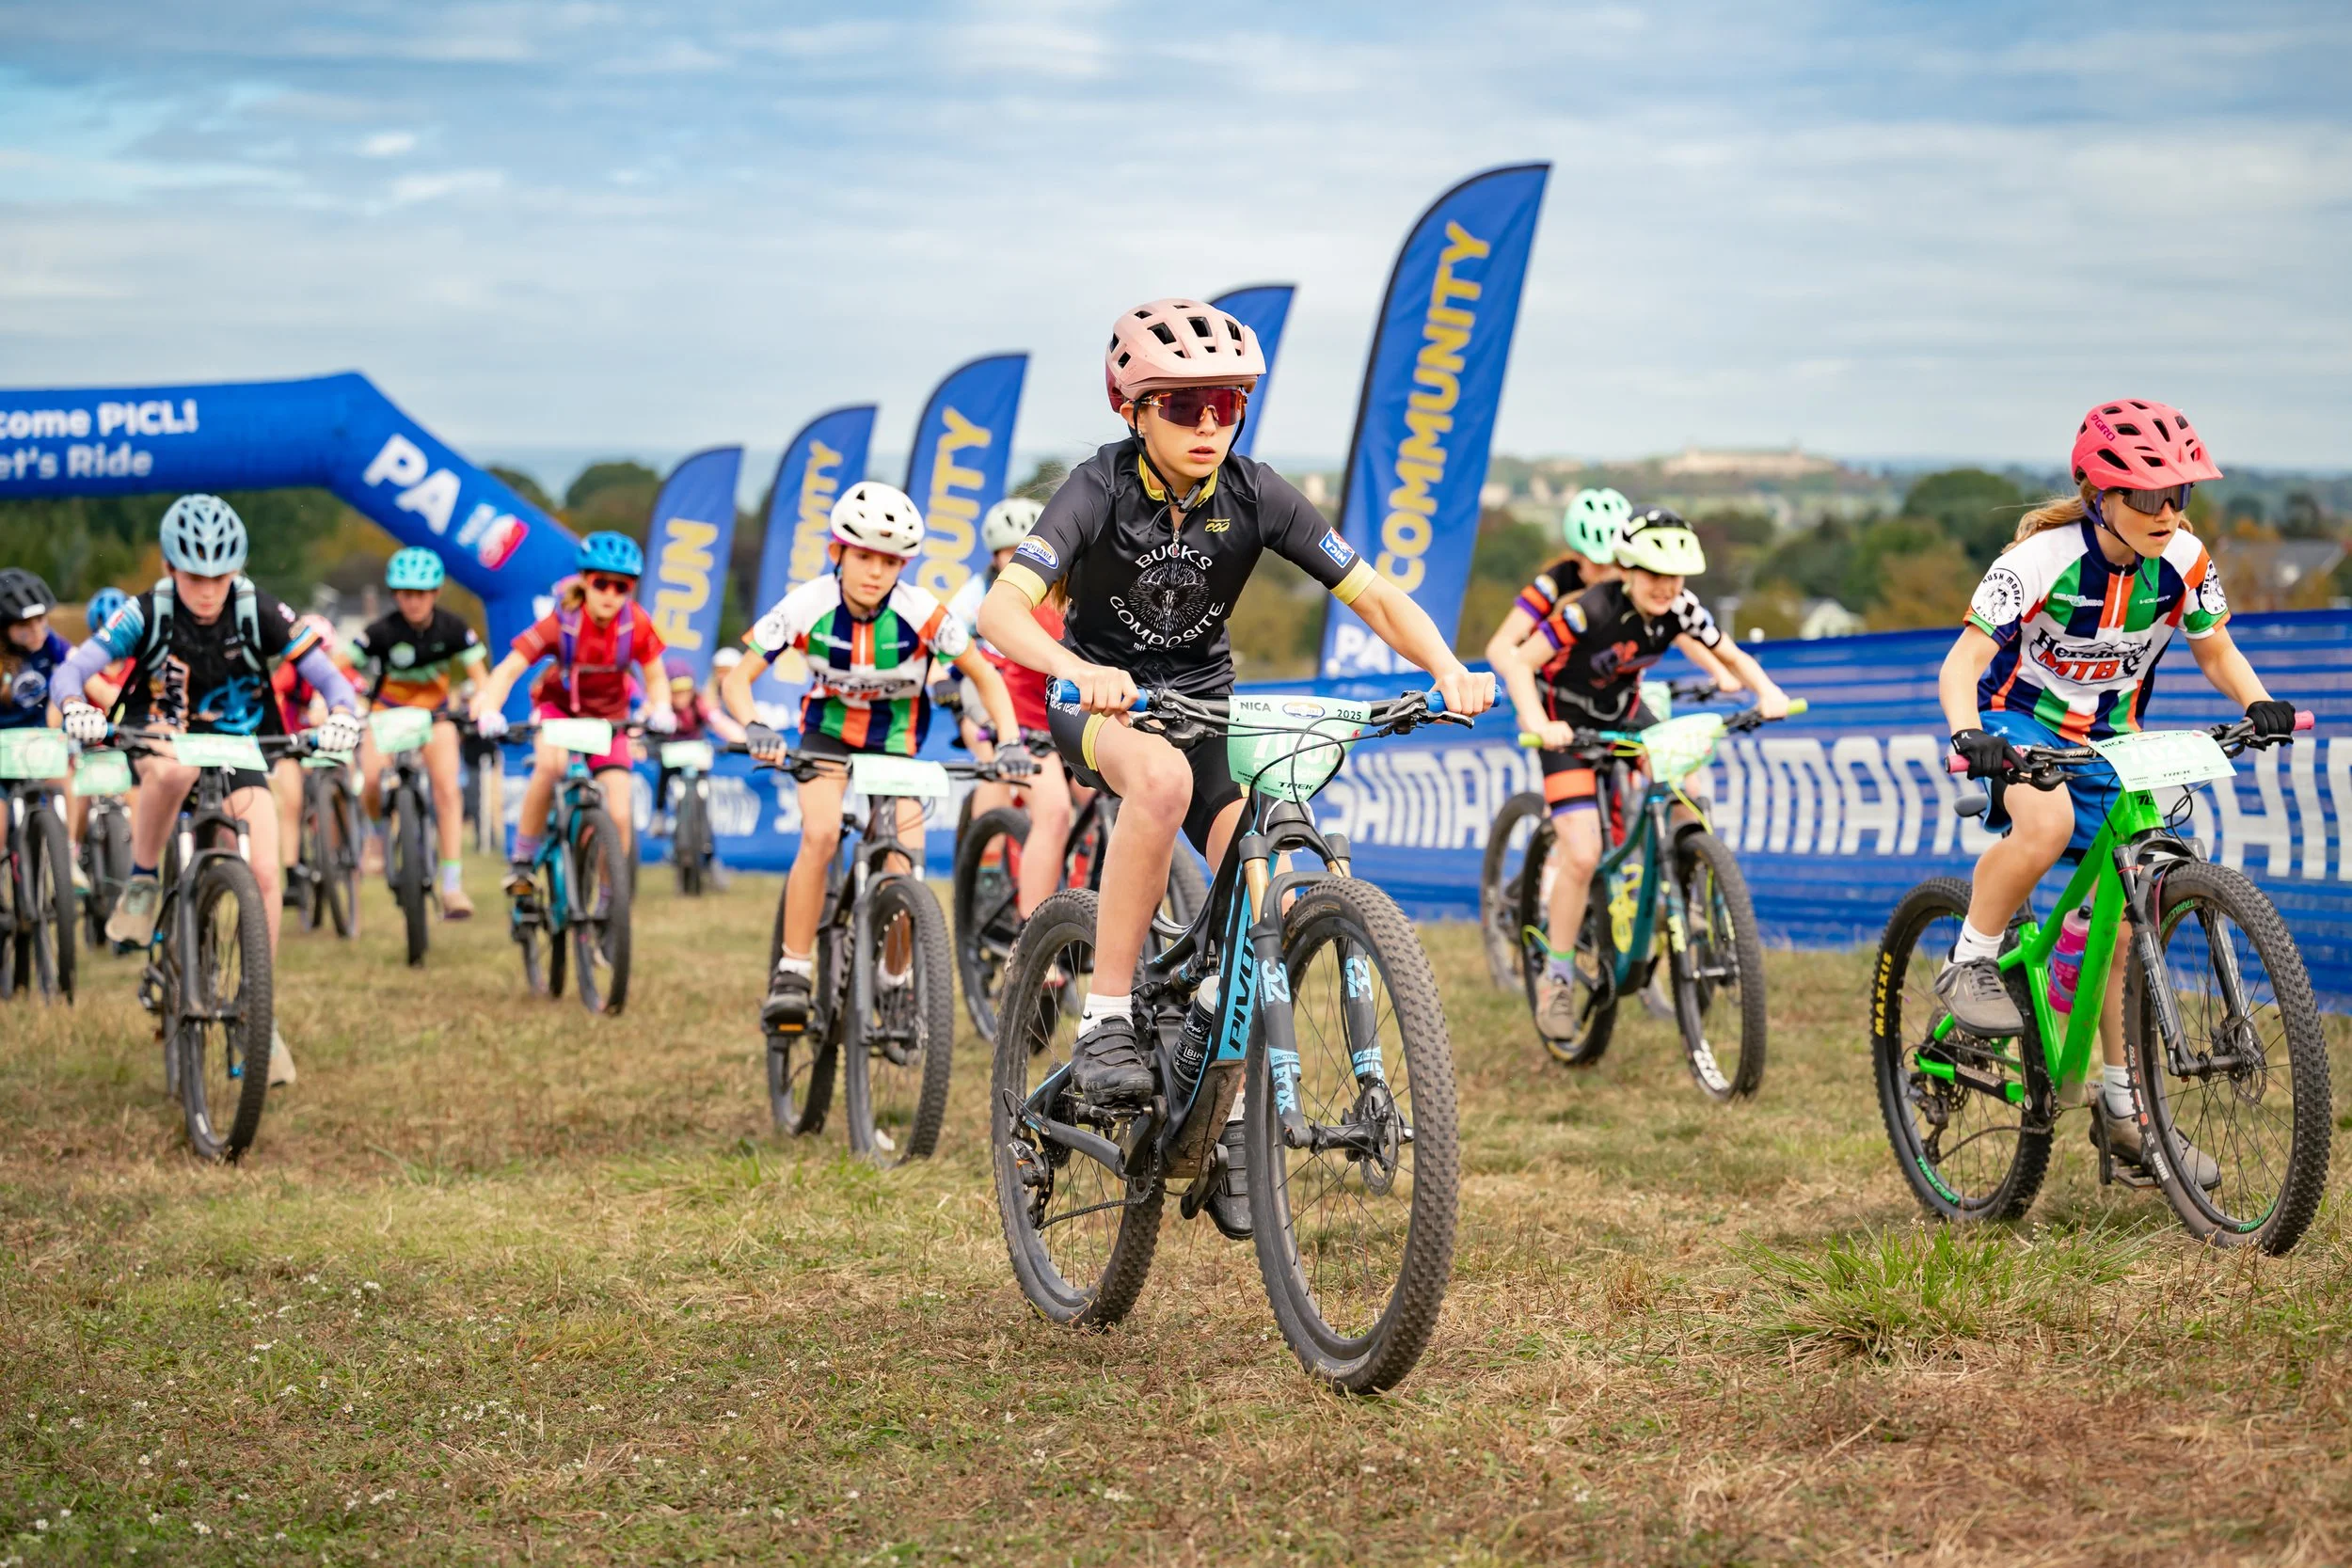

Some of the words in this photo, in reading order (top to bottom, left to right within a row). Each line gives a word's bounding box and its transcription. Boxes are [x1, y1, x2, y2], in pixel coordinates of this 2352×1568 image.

[1375, 220, 1490, 594] COMMUNITY
[2094, 419, 2116, 442] GIRO
[67, 441, 152, 479] Ride
[916, 408, 992, 602] QUITY
[1135, 544, 1213, 570] BUCKS
[1326, 539, 1347, 563] NICA
[656, 518, 719, 652] FUN
[1110, 595, 1225, 649] COMPOSITE
[2038, 650, 2121, 681] MTB
[1240, 702, 1271, 712] NICA
[1337, 709, 1362, 721] 2025
[1278, 781, 1313, 791] TREK
[1699, 736, 2004, 855] HIMAN
[1229, 913, 1257, 1053] PIVOT
[1262, 958, 1292, 1003] 32
[1875, 952, 1892, 1037] MAXXIS
[1273, 1065, 1296, 1117] FOX
